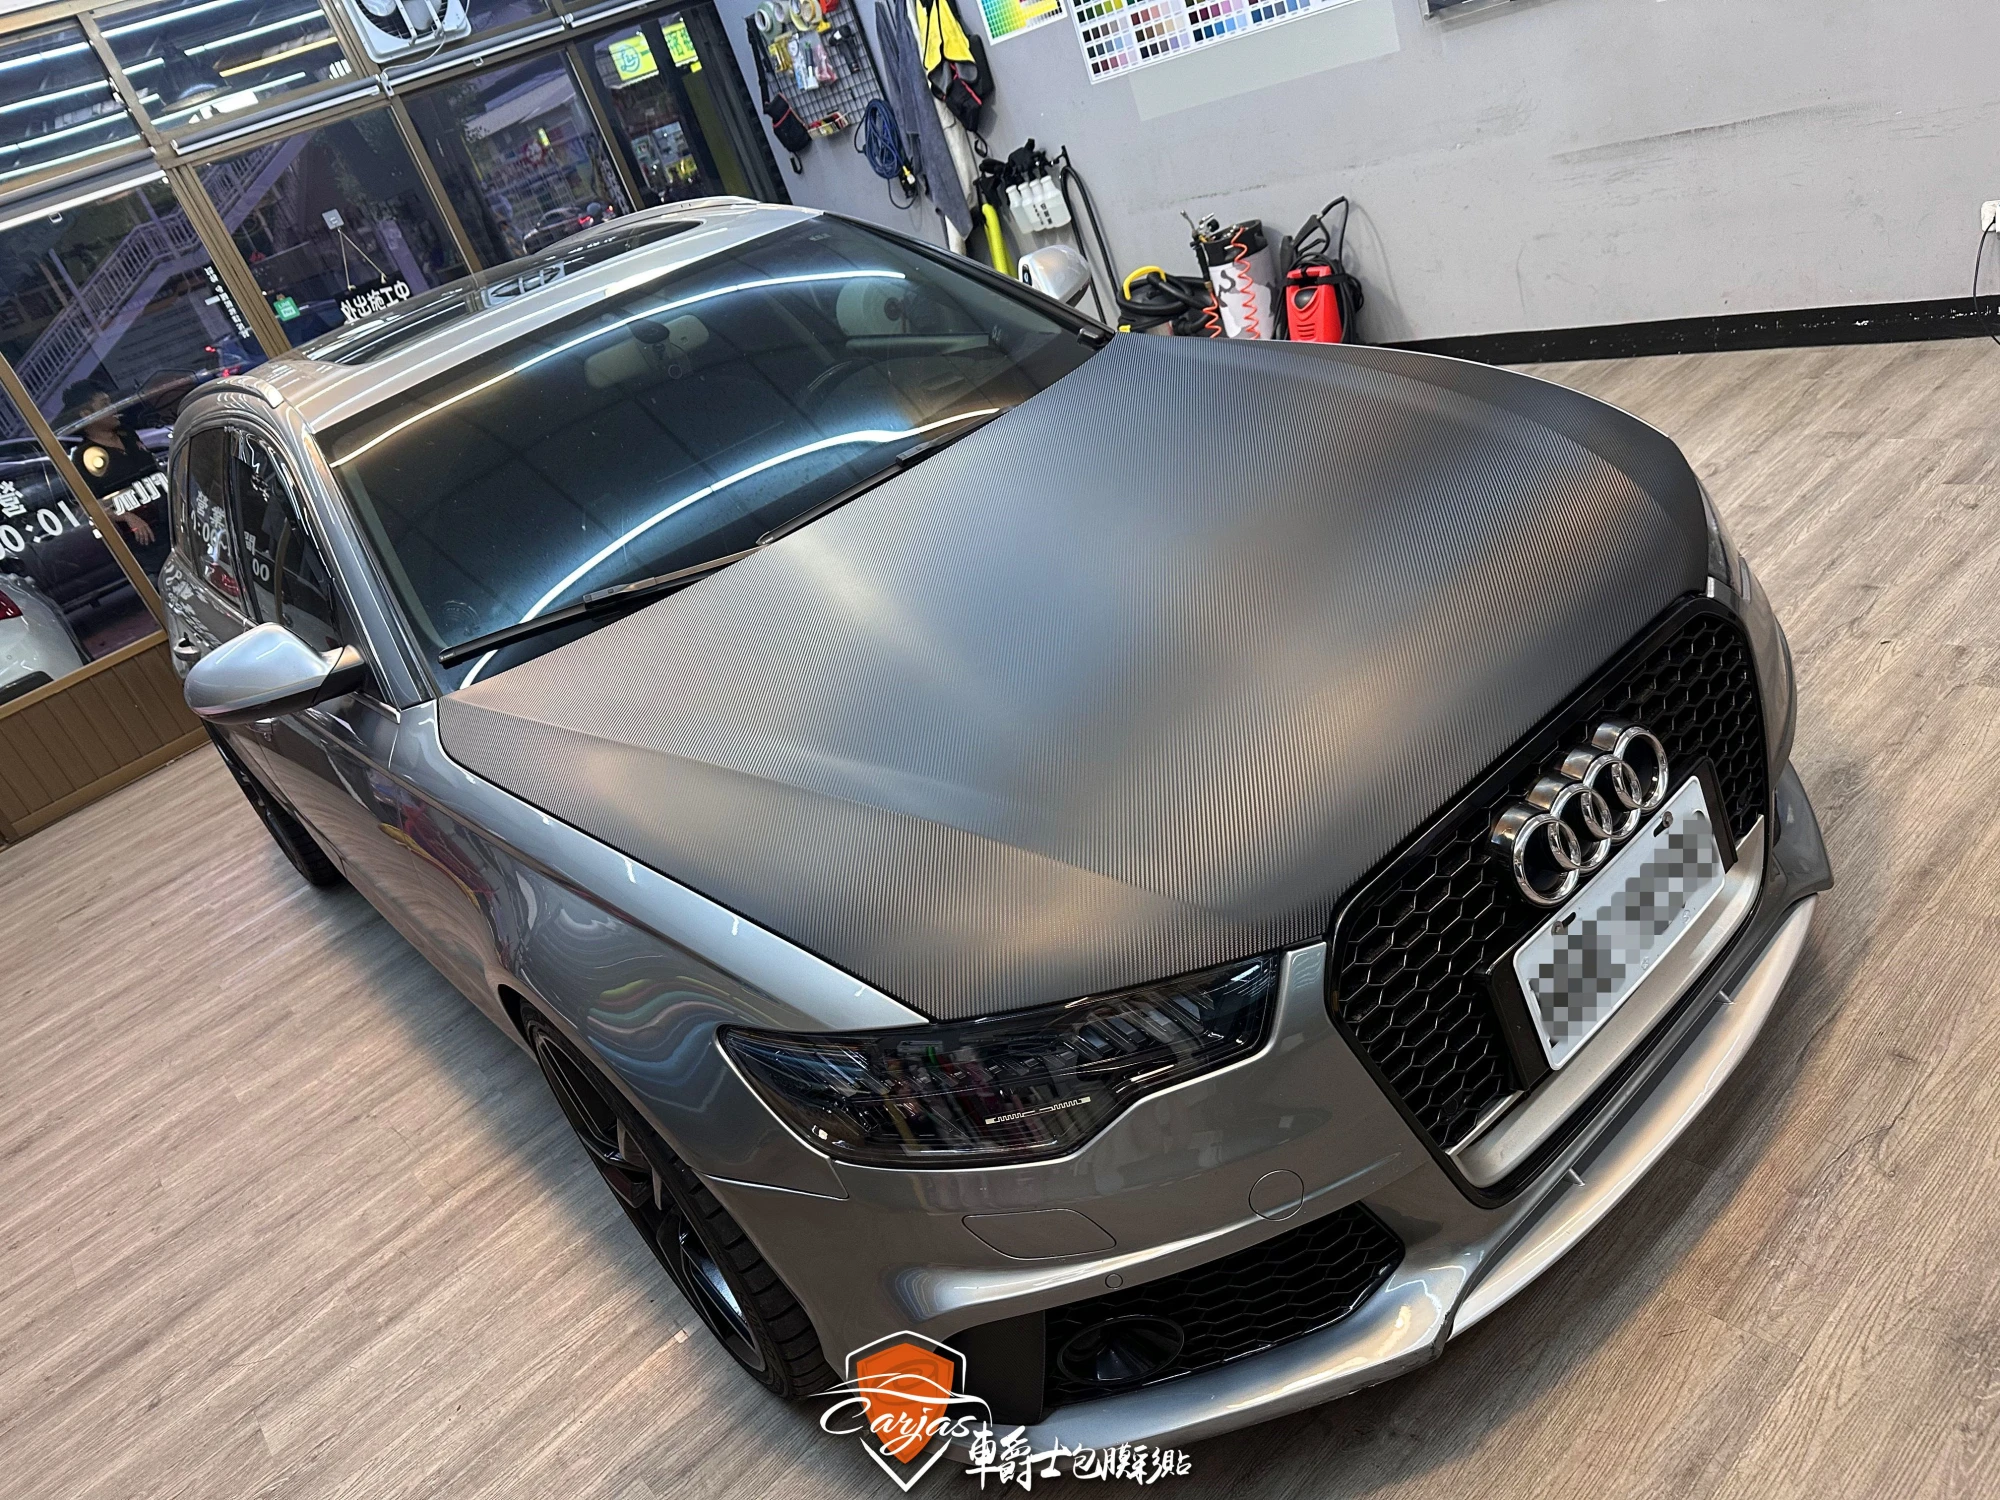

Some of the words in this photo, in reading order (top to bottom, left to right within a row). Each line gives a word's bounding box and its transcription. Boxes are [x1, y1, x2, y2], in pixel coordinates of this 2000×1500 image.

[340, 280, 411, 322] 外出施工中
